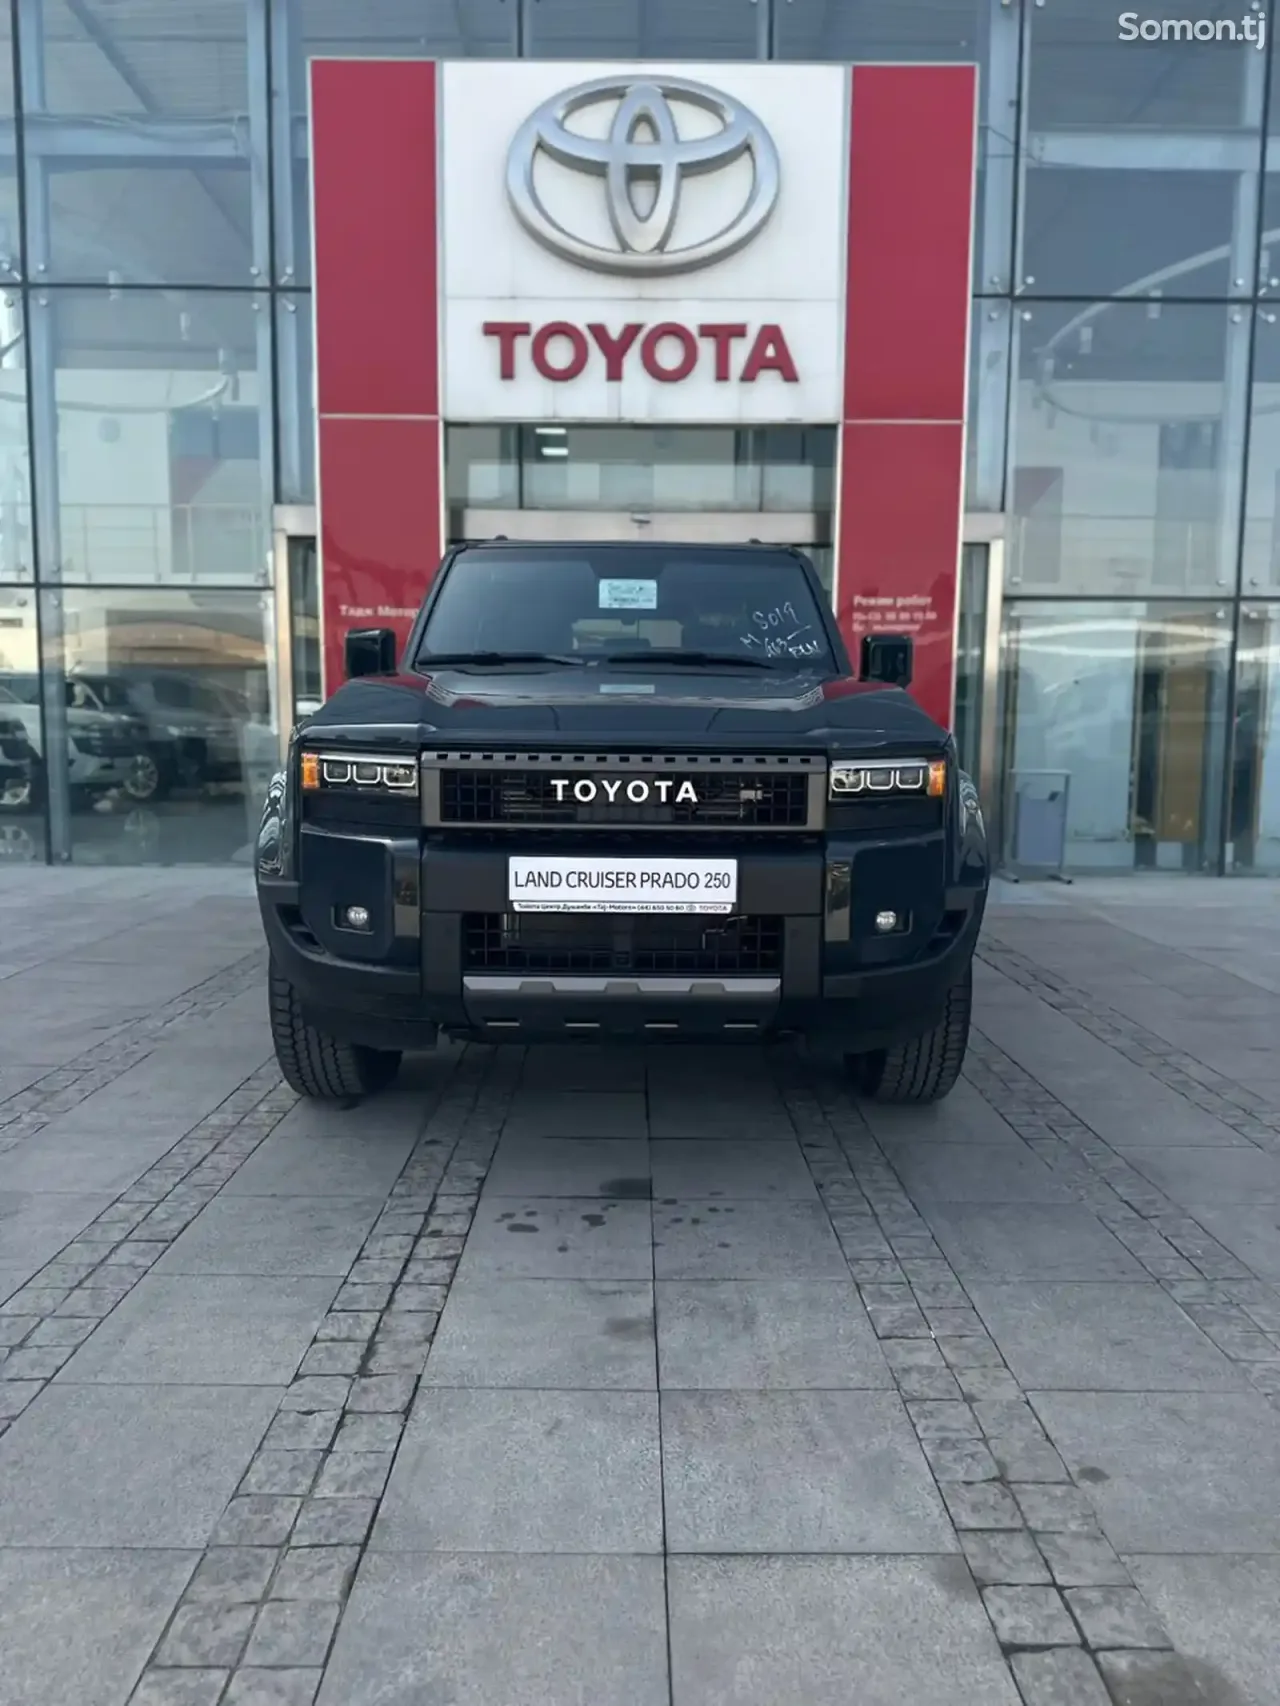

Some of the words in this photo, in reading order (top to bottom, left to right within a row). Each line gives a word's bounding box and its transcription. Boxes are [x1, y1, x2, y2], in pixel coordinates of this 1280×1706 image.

[483, 321, 799, 383] TOYOTA
[550, 779, 698, 803] TOYOTA
[514, 870, 562, 888] LAND
[565, 871, 637, 889] CRUISER
[640, 872, 700, 889] PRADO
[704, 872, 731, 889] 250
